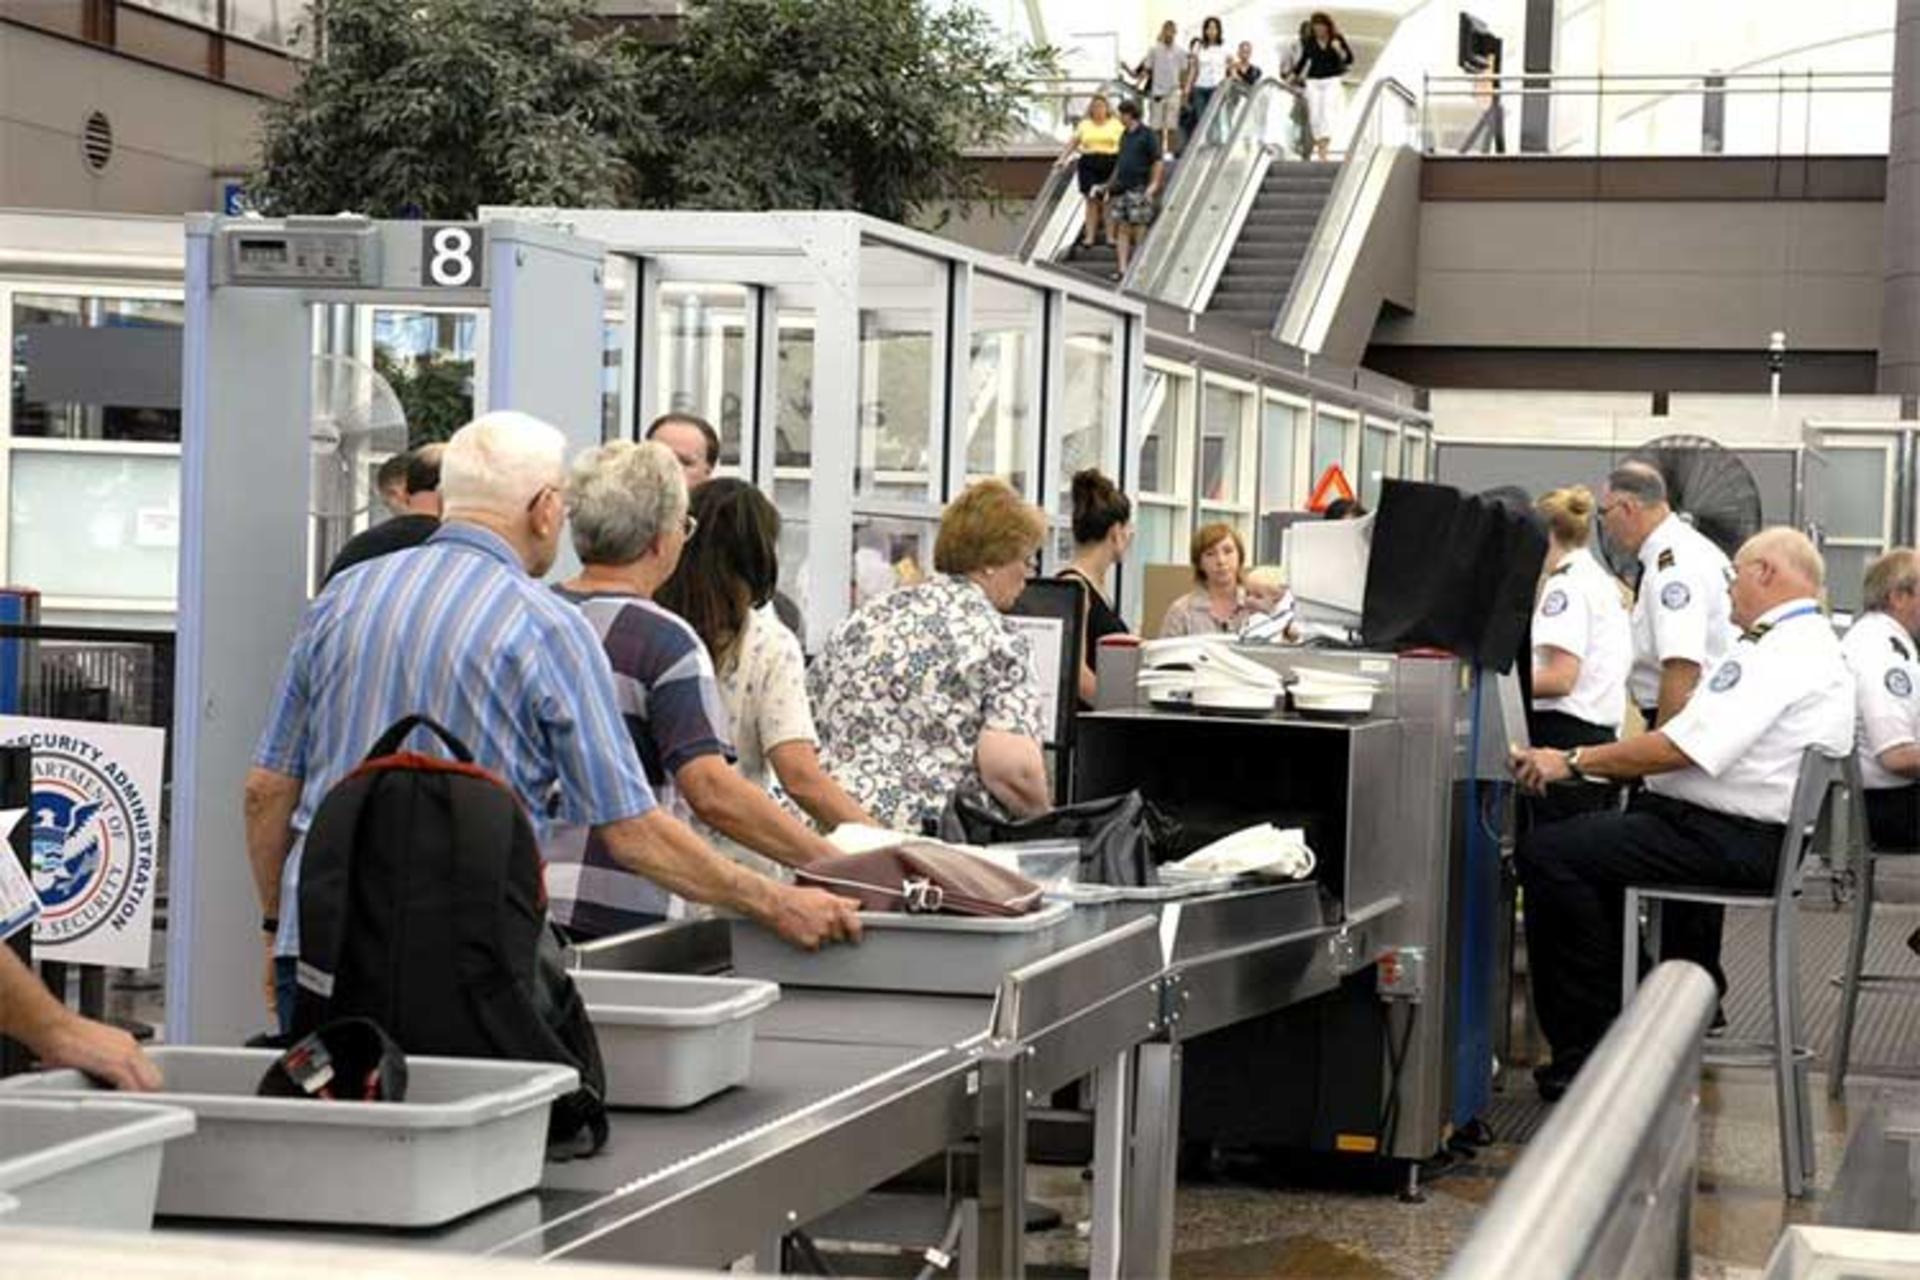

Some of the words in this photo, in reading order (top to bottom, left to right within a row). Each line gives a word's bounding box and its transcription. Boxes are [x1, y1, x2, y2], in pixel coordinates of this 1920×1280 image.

[430, 227, 474, 286] 8
[31, 760, 115, 812] ARTMENT
[104, 762, 153, 931] ADMINISTRATION
[50, 865, 122, 935] SECURITY
